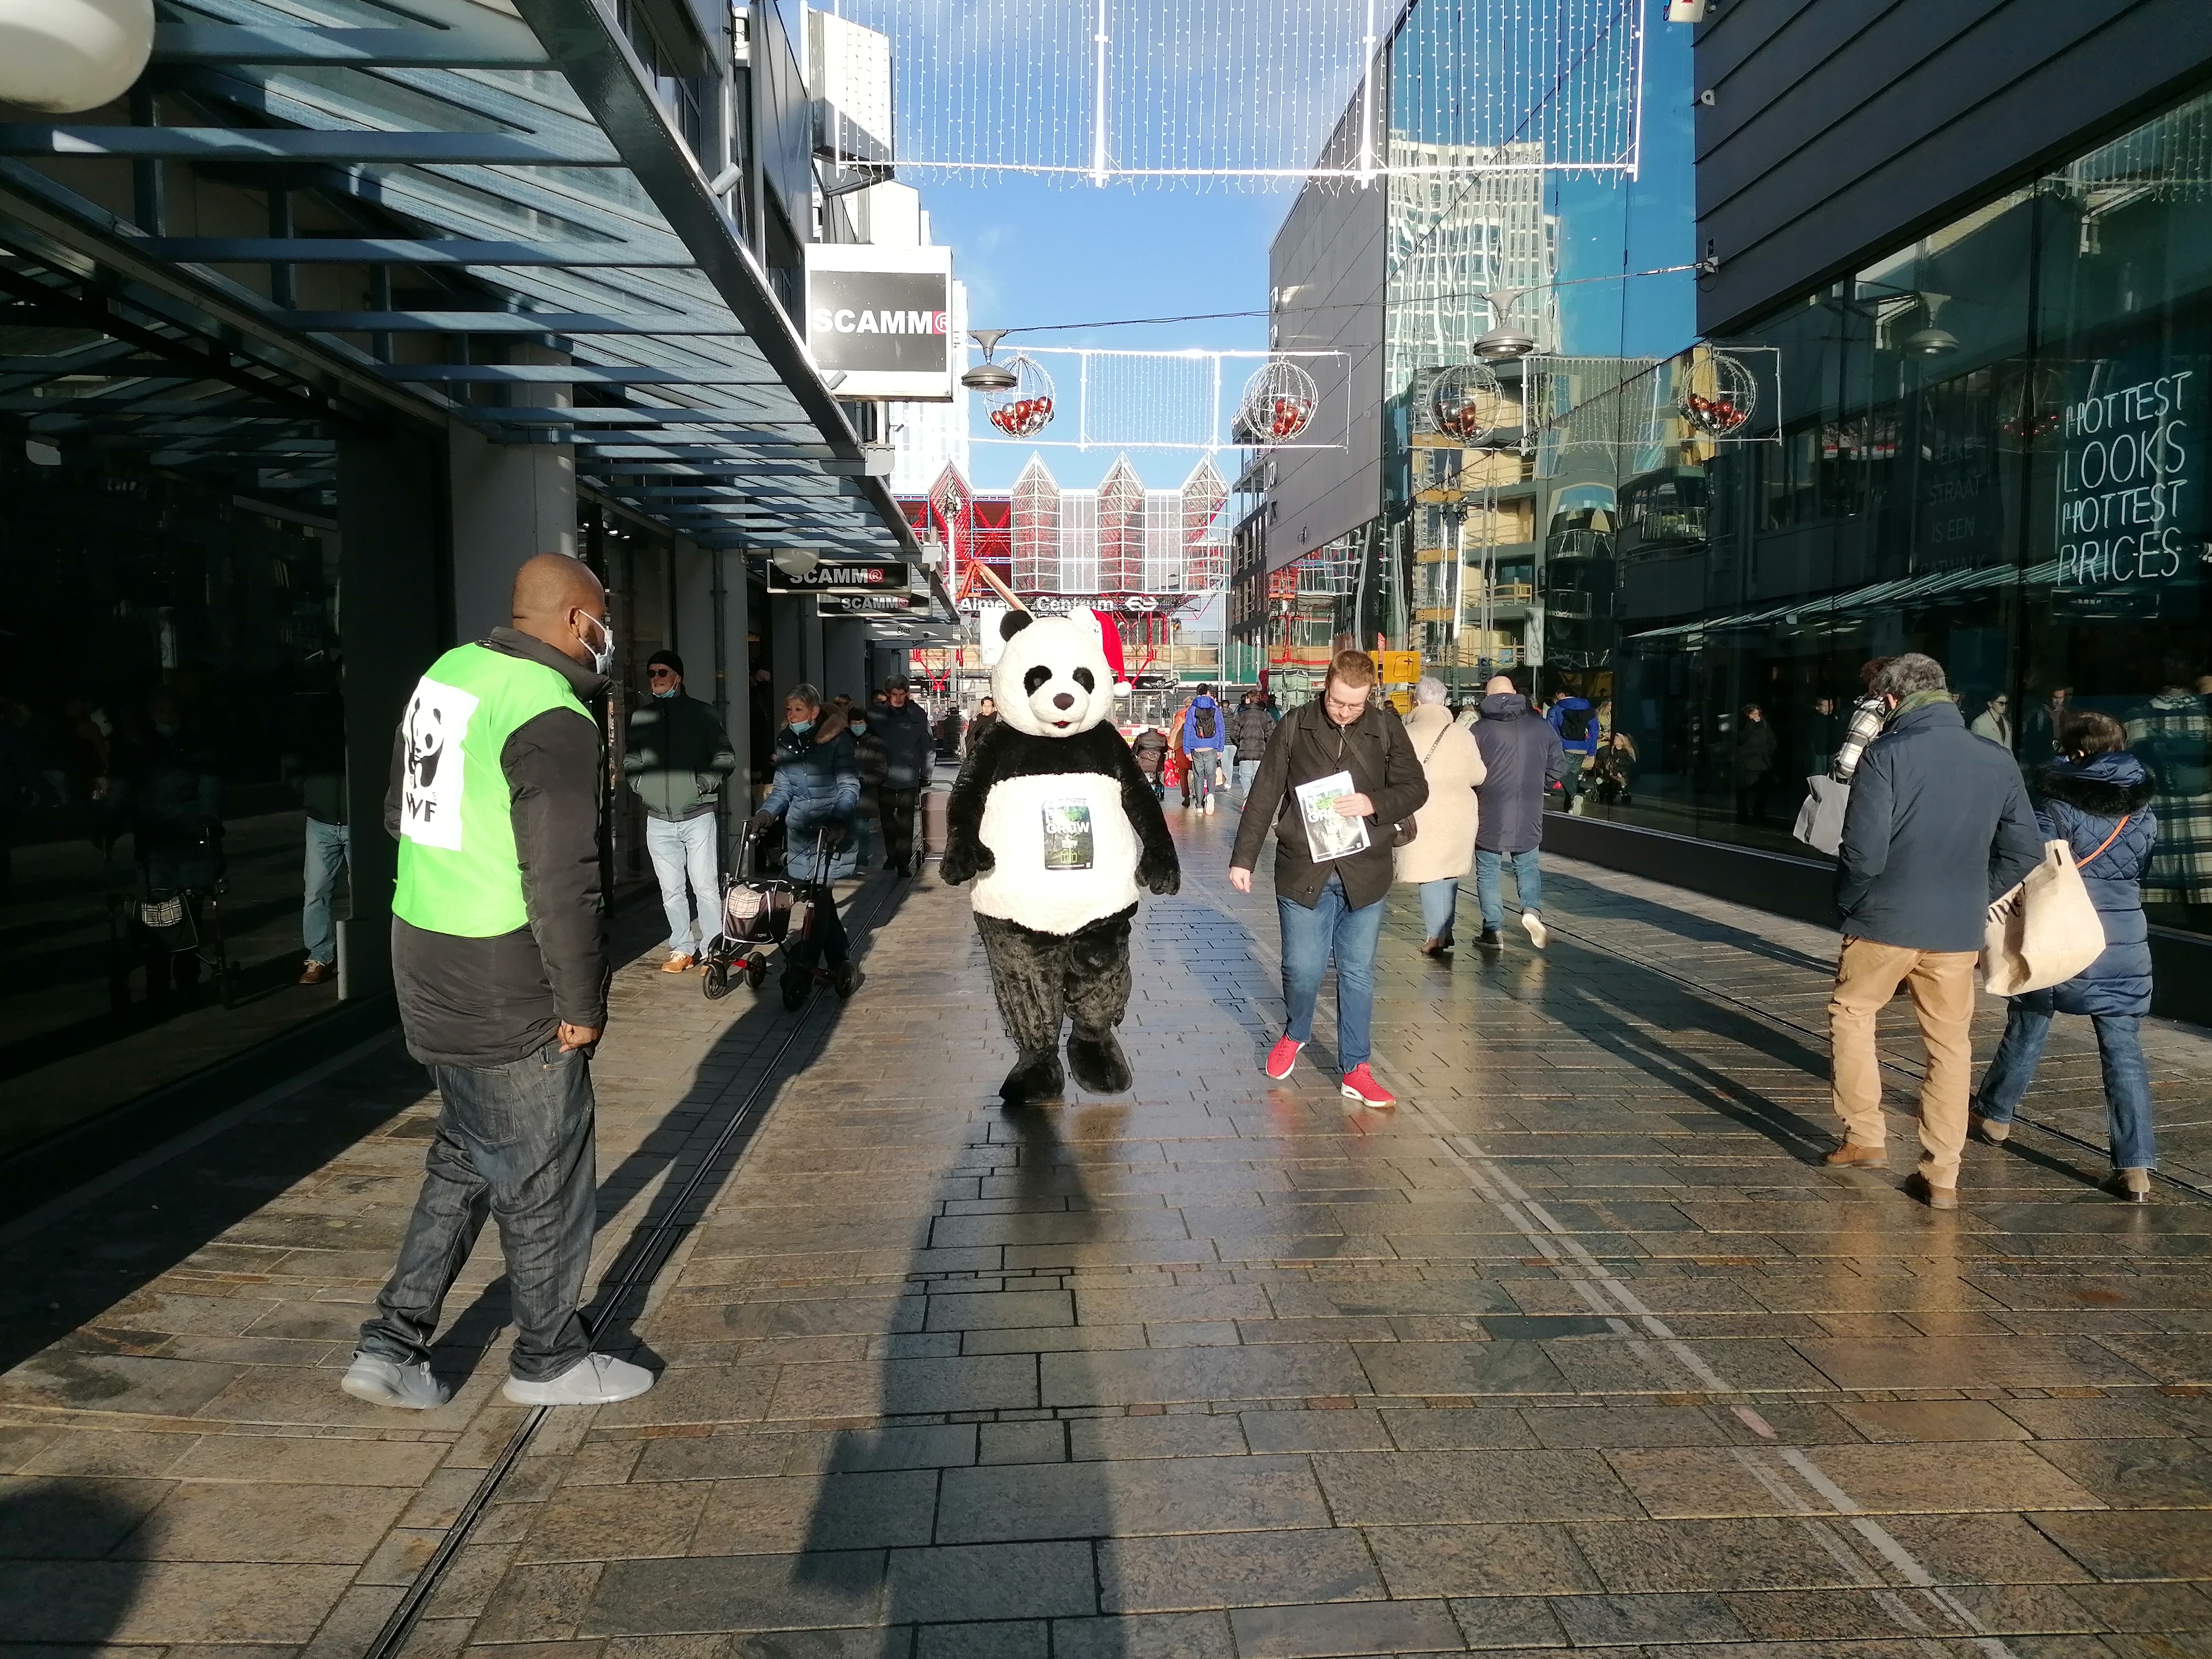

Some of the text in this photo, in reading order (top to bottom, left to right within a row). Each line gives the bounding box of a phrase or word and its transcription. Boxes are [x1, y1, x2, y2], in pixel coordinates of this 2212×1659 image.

[2065, 371, 2193, 439] HOTTEST
[2063, 420, 2188, 493] LOOKS
[1929, 474, 1982, 506] STRAAT
[2062, 479, 2188, 535] HOTTEST
[1932, 516, 1975, 544] IS EEN
[2057, 526, 2183, 586] PRICES
[1046, 821, 1089, 834] GROW
[1307, 807, 1338, 823] GRO
